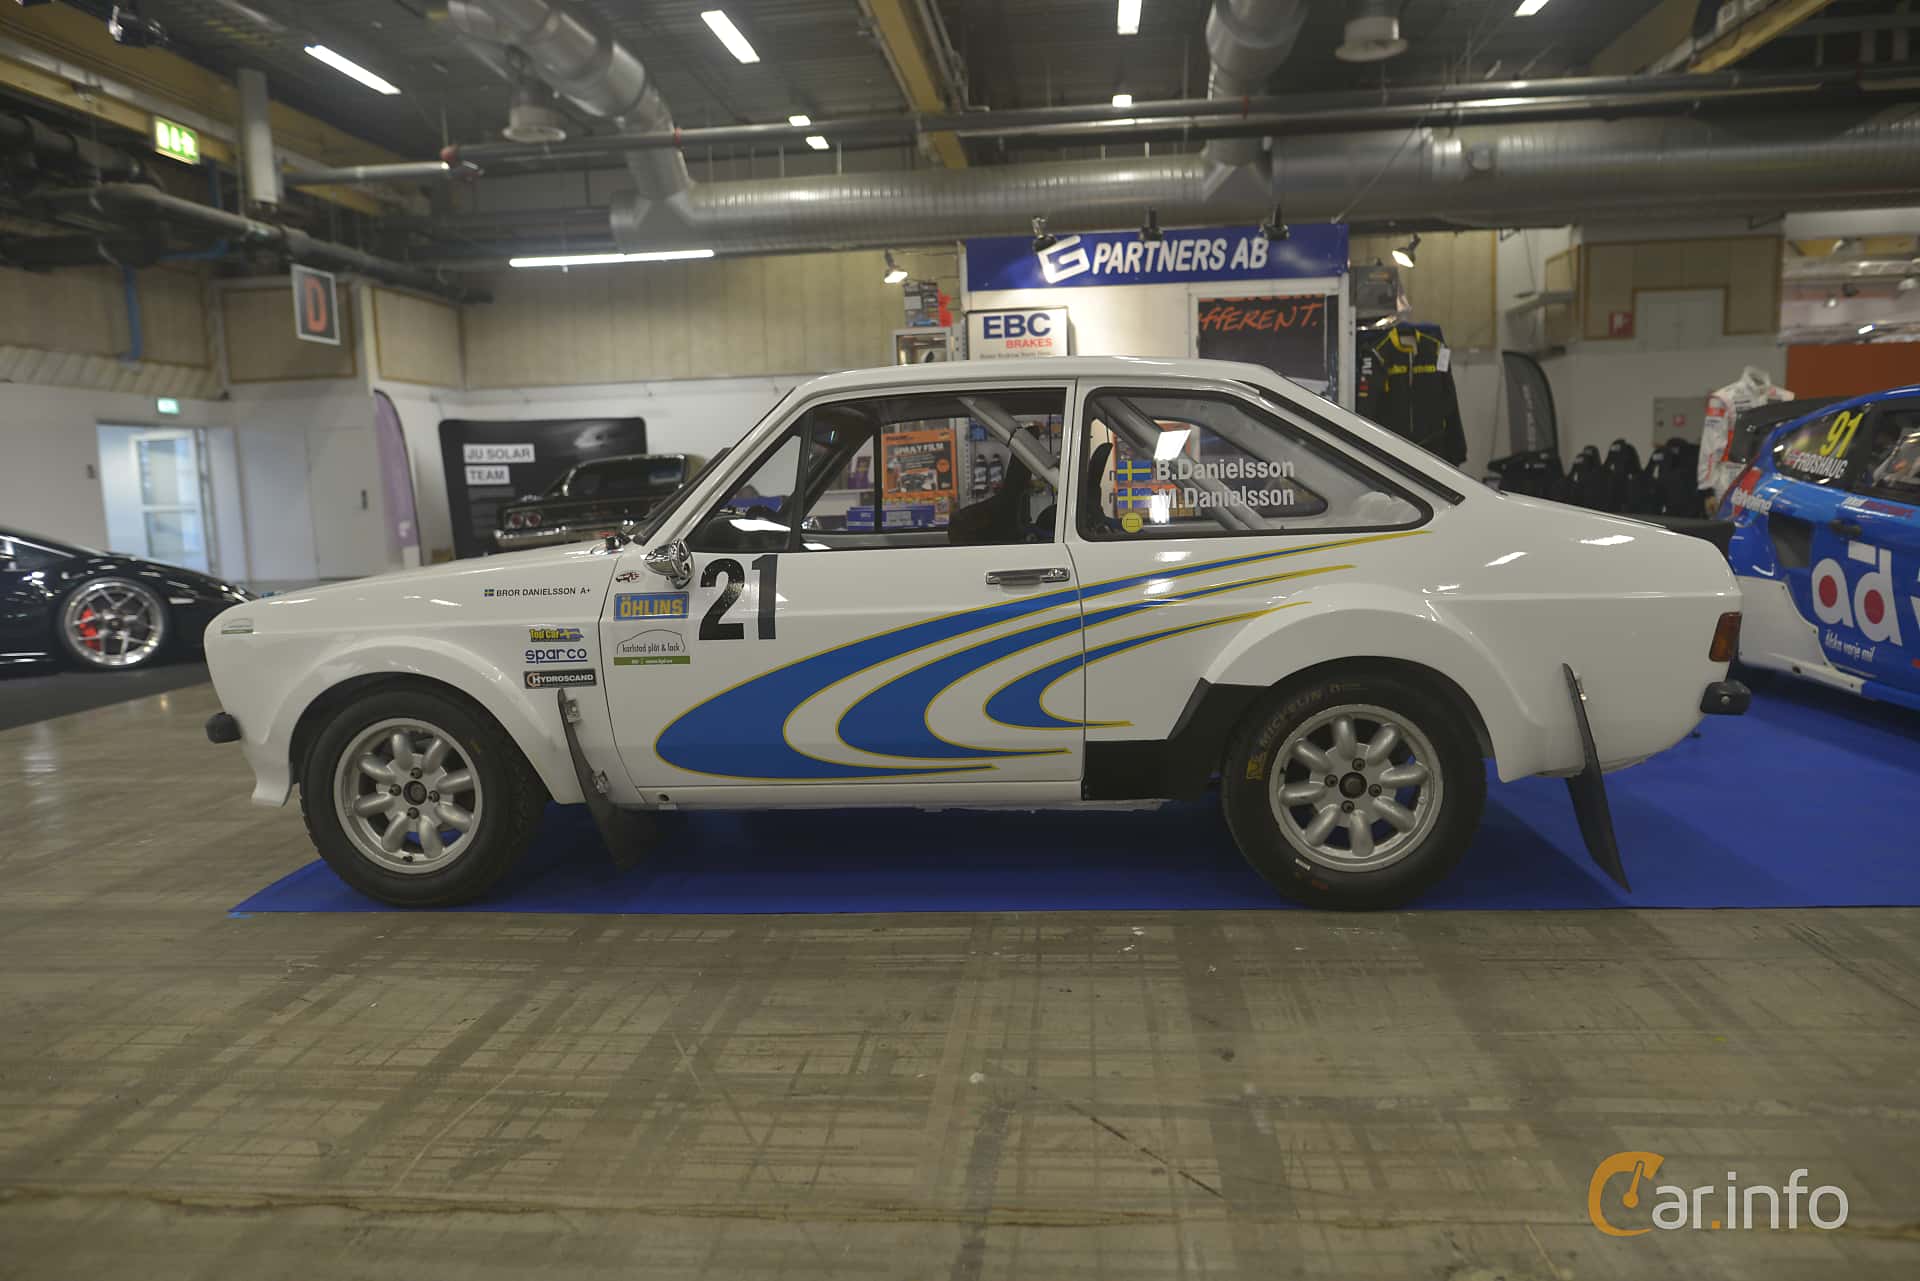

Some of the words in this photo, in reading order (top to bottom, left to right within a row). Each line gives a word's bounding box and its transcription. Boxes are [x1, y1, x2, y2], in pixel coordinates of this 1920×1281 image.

[1092, 239, 1227, 274] PARTNERS
[1230, 237, 1269, 270] AB
[304, 276, 328, 332] D
[983, 312, 1051, 340] EBC
[1005, 338, 1053, 349] BRAKES
[1819, 411, 1865, 458] 91
[467, 449, 484, 460] JU
[486, 449, 531, 460] SOLAR
[470, 470, 506, 481] TEAM
[1156, 458, 1295, 481] B.Danielsson
[1157, 486, 1295, 509] M.Danielsson
[496, 589, 520, 597] BROR
[522, 588, 576, 597] DANIELSSON
[580, 587, 591, 595] A+
[699, 554, 778, 640] 21
[620, 596, 683, 617] ÖHLINS
[525, 648, 587, 664] sparco
